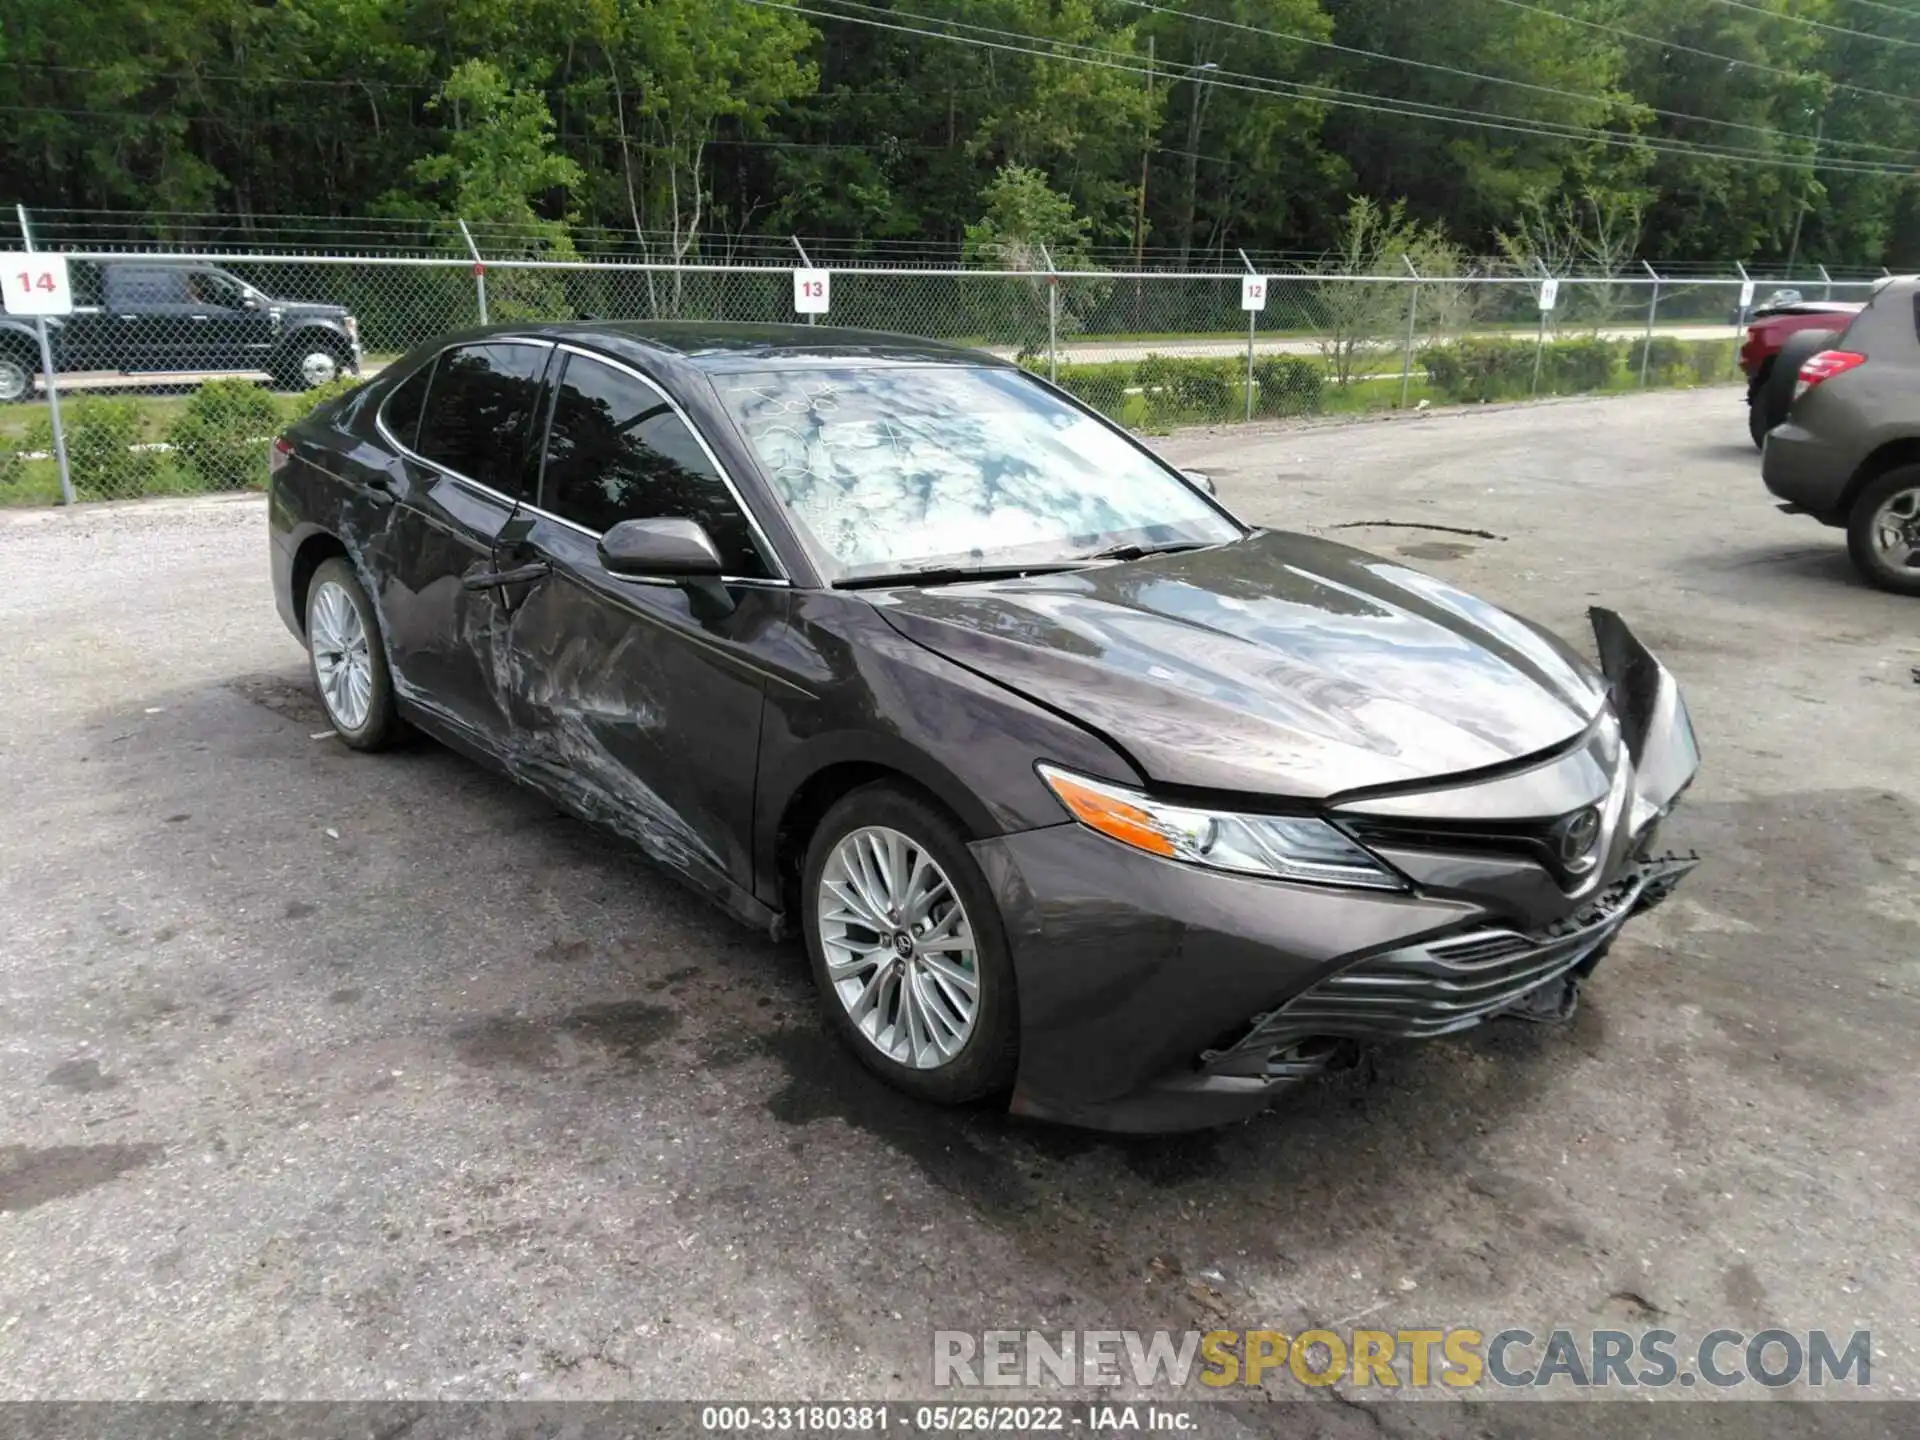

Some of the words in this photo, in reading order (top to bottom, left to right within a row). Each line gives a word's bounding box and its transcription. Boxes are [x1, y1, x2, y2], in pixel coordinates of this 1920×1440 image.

[17, 271, 56, 293] 14
[802, 281, 823, 297] 13
[1248, 285, 1262, 298] 12
